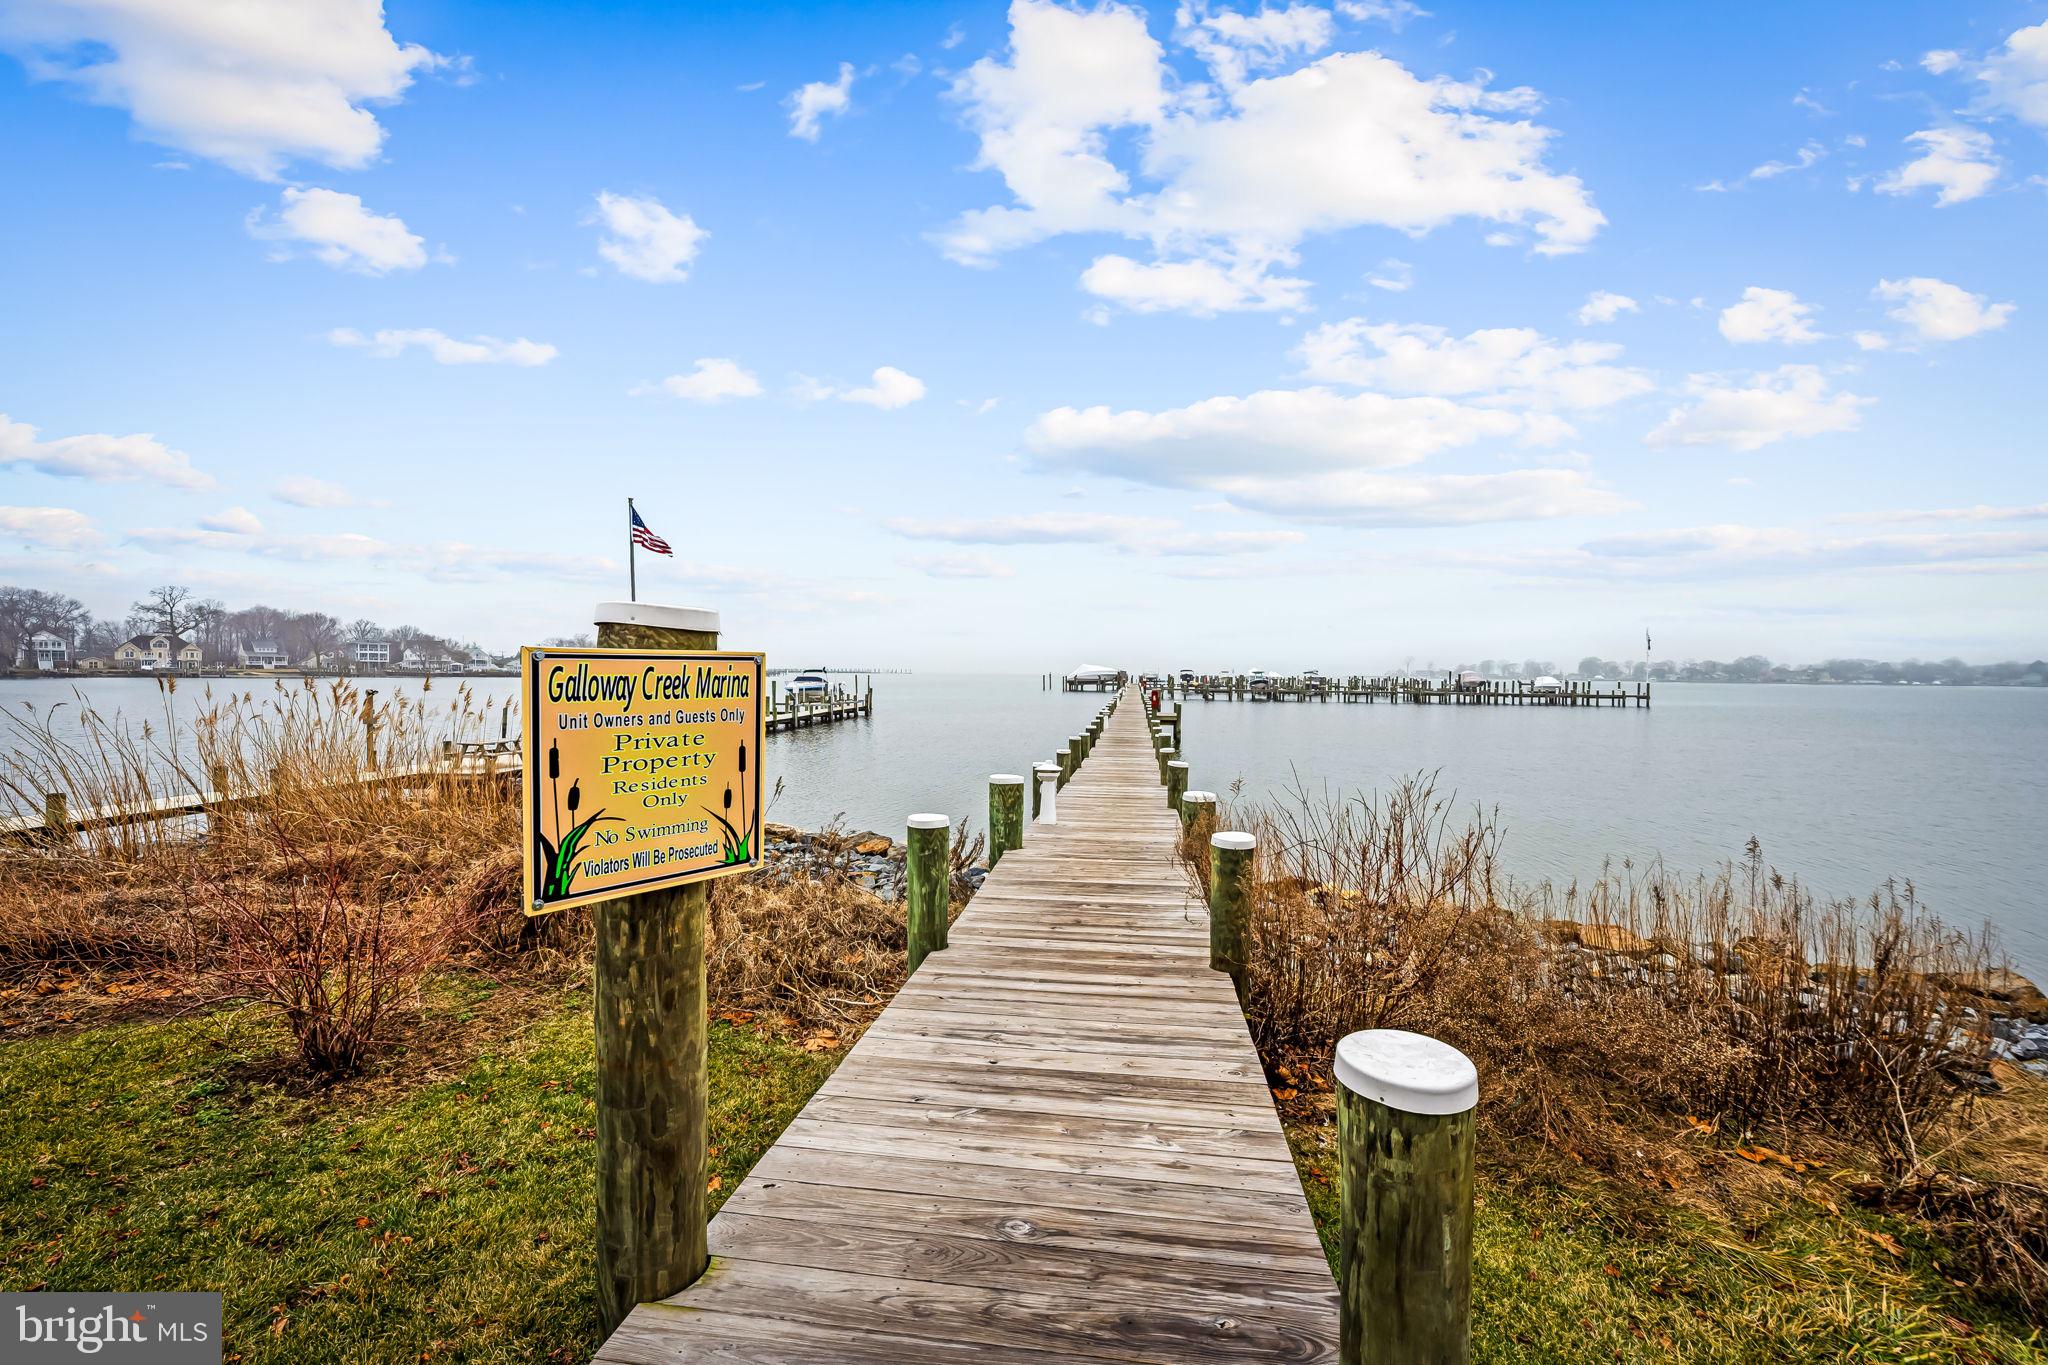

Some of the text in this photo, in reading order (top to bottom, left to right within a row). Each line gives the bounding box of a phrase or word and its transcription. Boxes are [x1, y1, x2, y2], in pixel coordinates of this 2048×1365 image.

[548, 664, 750, 712] Galloway Creek Marina
[558, 708, 745, 730] Unit Owners and Guests Only
[613, 732, 705, 752] Private
[601, 752, 717, 775] Property
[612, 775, 708, 795] Residents
[642, 792, 688, 808] Only
[594, 818, 709, 847] No Swimming
[582, 839, 718, 878] Violators Will Be Prosecuted
